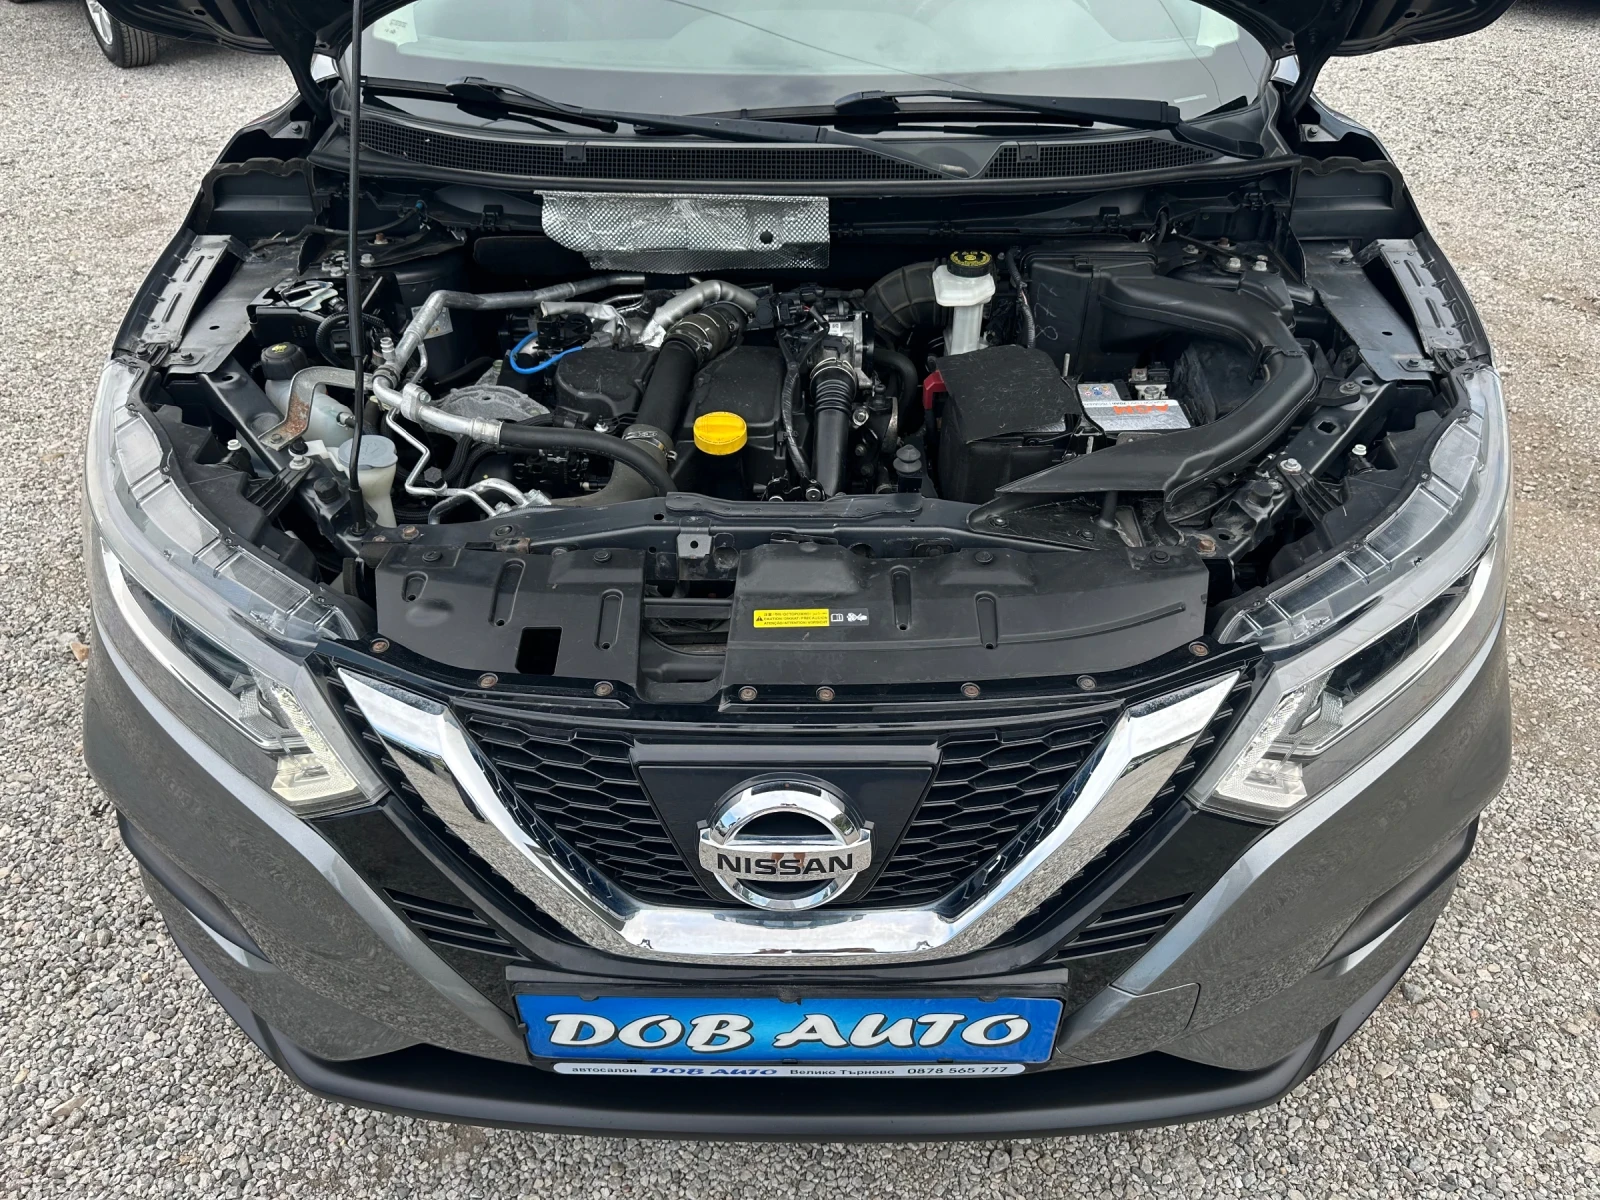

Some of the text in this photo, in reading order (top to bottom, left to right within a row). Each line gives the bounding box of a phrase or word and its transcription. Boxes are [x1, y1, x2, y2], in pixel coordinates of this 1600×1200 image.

[717, 853, 853, 875] NISSAN
[545, 1013, 1031, 1052] DOB AUTO
[650, 1067, 705, 1075] DOB
[710, 1067, 777, 1075] AUTO
